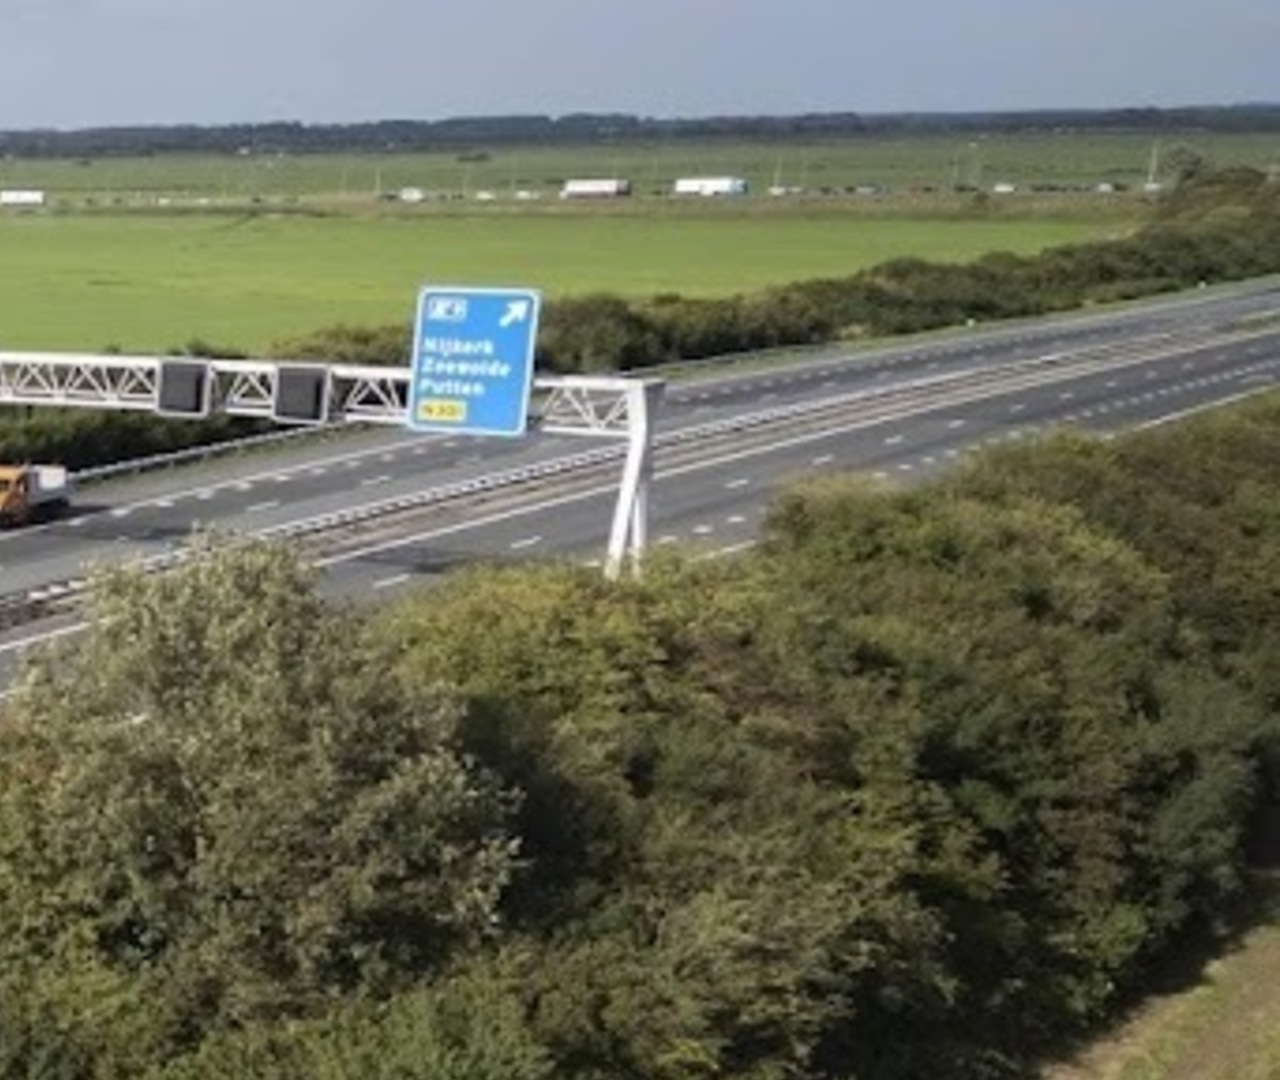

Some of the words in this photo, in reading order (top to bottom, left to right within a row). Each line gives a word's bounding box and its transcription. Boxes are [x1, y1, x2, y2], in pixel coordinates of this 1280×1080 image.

[424, 337, 493, 357] Nijkerk
[421, 356, 511, 377] Zeewolde
[420, 378, 485, 395] Putten
